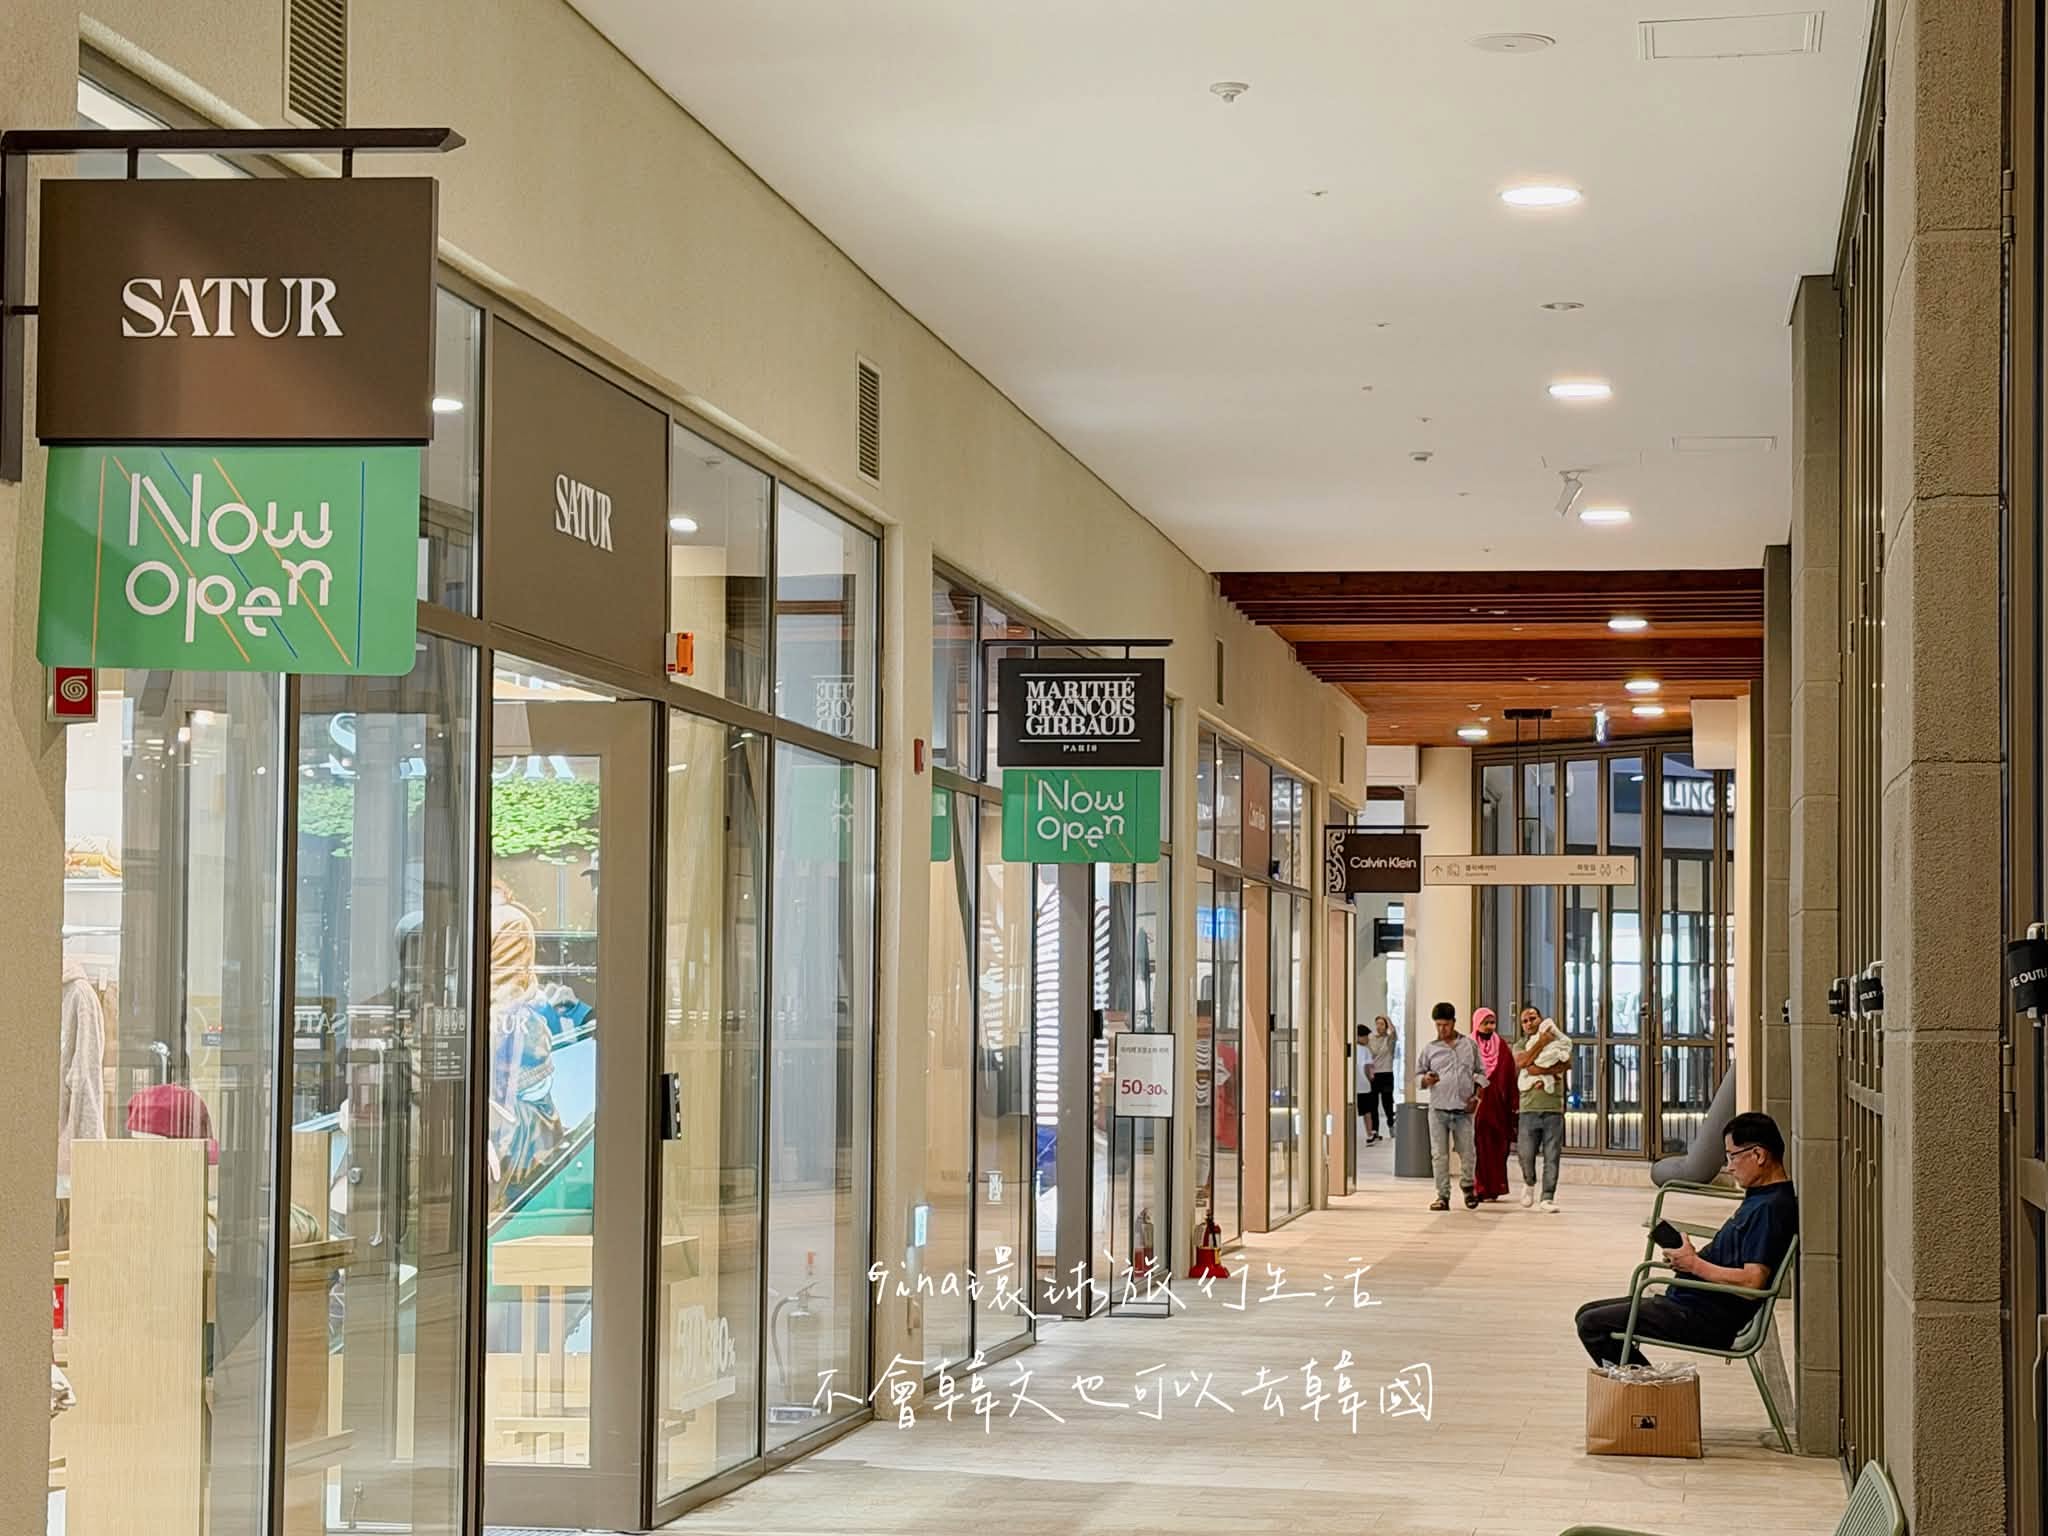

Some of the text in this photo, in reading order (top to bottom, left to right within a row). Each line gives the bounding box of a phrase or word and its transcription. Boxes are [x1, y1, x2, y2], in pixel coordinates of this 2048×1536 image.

[121, 278, 343, 338] SATUR
[129, 473, 333, 553] Now
[554, 474, 613, 552] SATUR
[1026, 677, 1135, 699] MARITHÉ
[1025, 716, 1135, 735] GIRBAUD
[1037, 779, 1125, 813] Now
[1350, 857, 1417, 868] Calvin Klein
